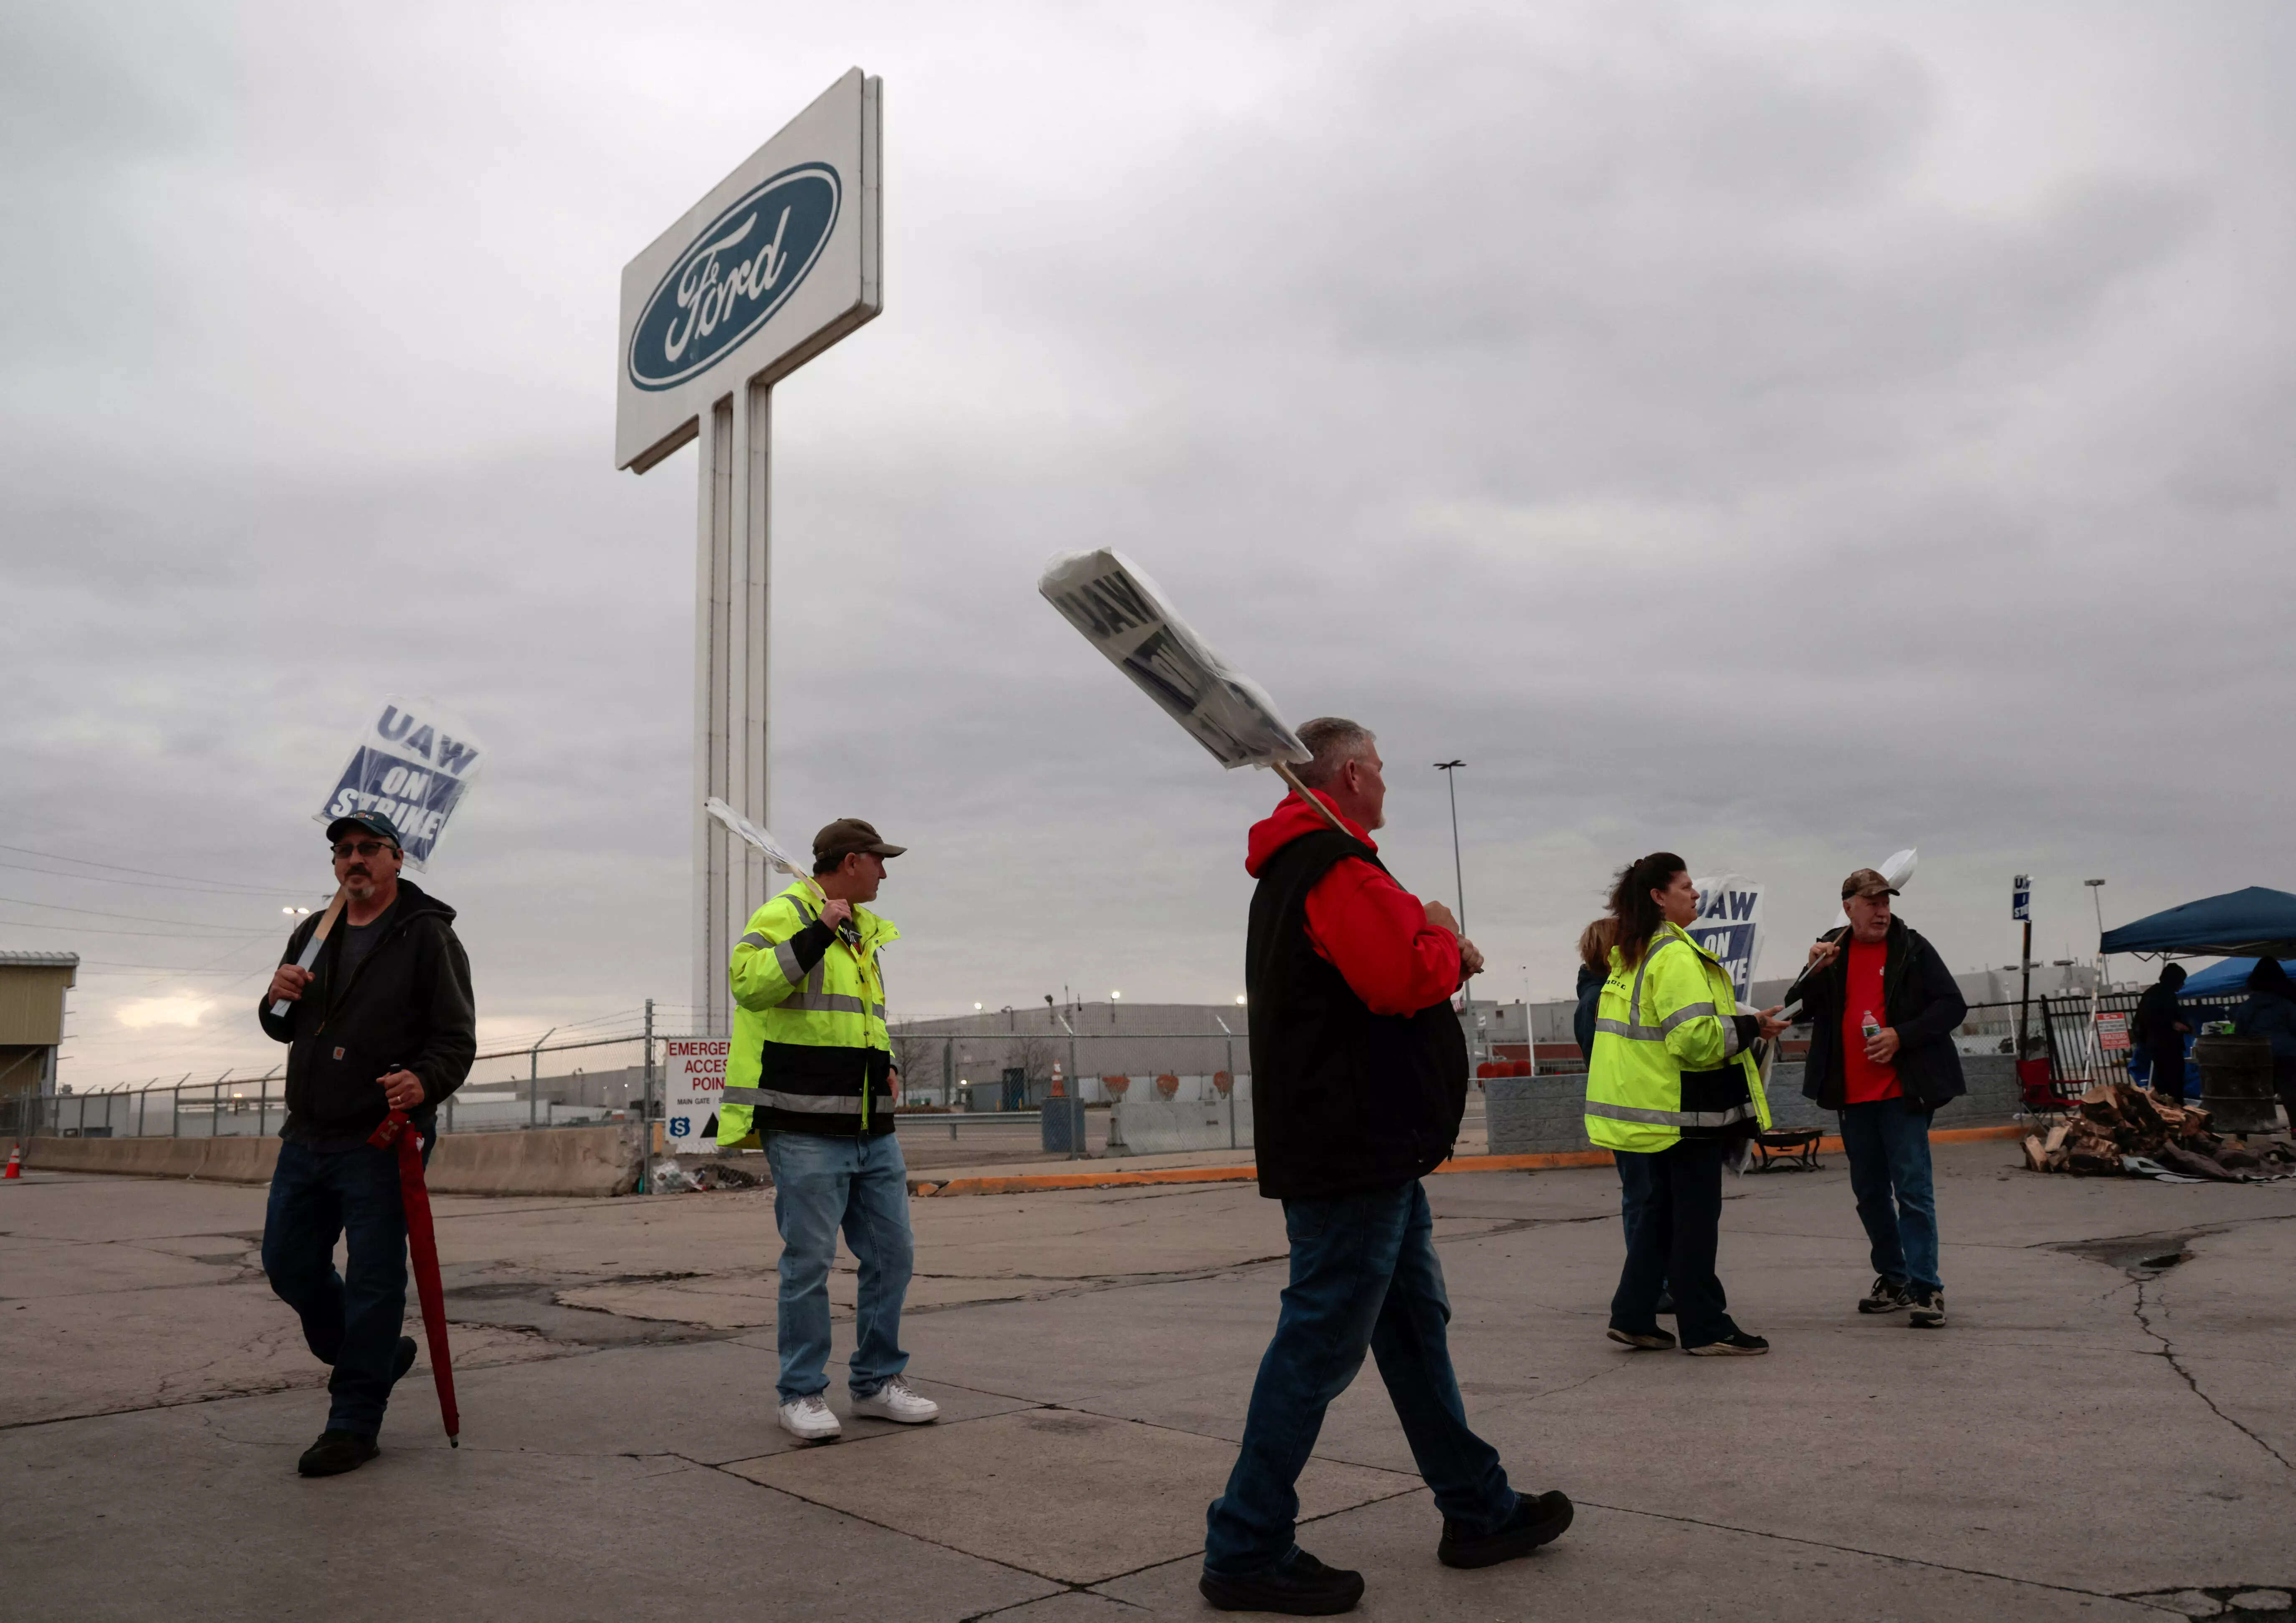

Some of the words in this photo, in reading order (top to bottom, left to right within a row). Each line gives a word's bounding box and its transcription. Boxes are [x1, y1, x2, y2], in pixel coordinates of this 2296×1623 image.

[665, 205, 791, 362] Ford
[1054, 570, 1159, 639] UAW
[377, 705, 478, 775] UAW
[381, 767, 430, 801] ON
[330, 788, 443, 840] STRIKE
[1704, 931, 1731, 958] ON
[693, 1077, 725, 1090] POIN
[674, 1121, 685, 1136] S
